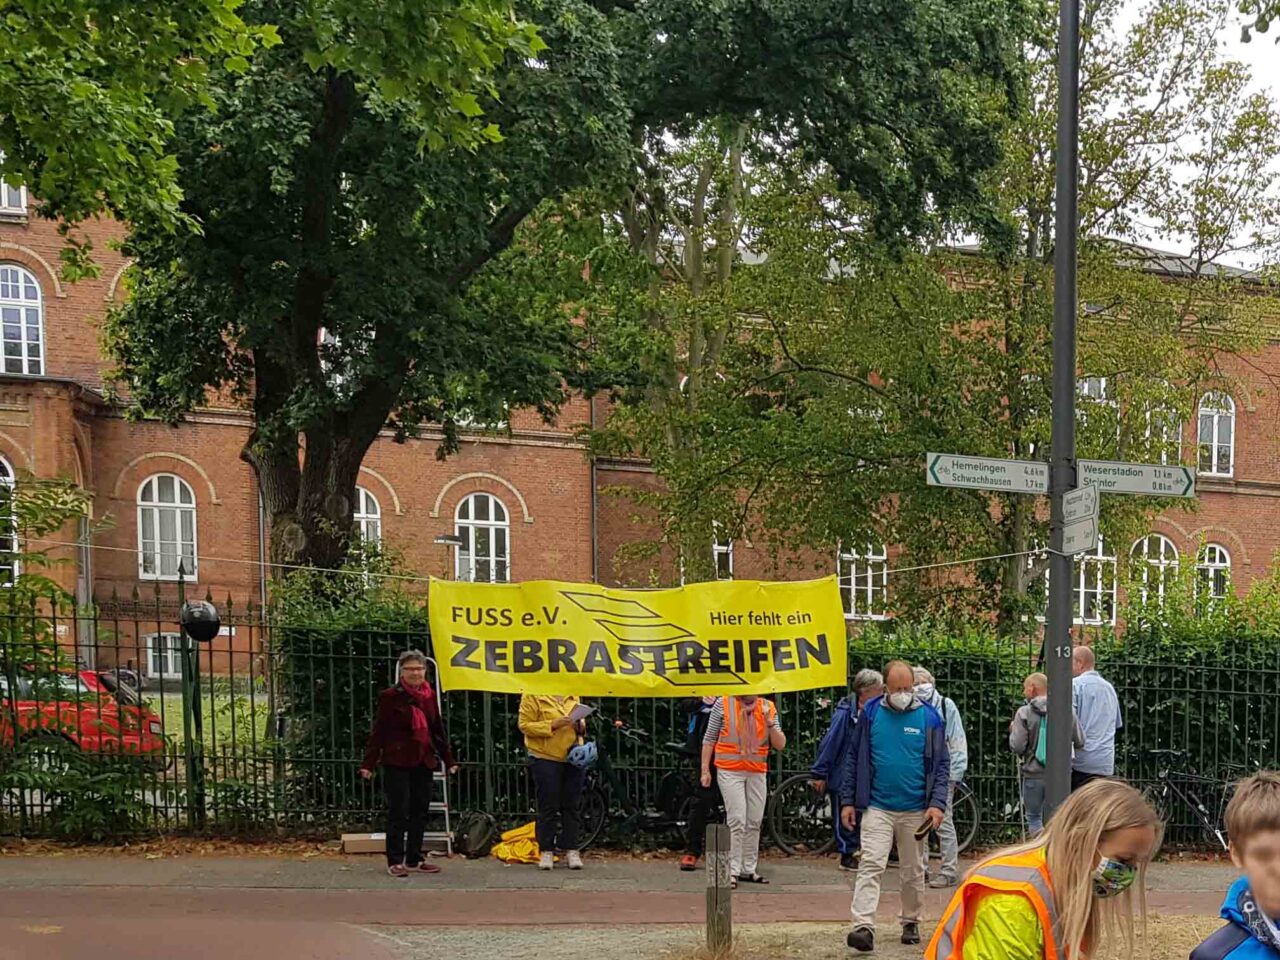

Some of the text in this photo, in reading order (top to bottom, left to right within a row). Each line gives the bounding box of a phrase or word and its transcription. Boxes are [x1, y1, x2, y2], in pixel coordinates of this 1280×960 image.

[951, 460, 1006, 475] Hemelingen
[1083, 464, 1144, 477] Weserstadion
[1163, 469, 1173, 479] km
[951, 473, 1012, 487] Schwachhausen
[451, 606, 568, 627] FUSS e.V.
[710, 611, 812, 626] Hier fehlt ein
[450, 633, 832, 676] ZEBRASTREIFEN
[1055, 646, 1071, 658] 13
